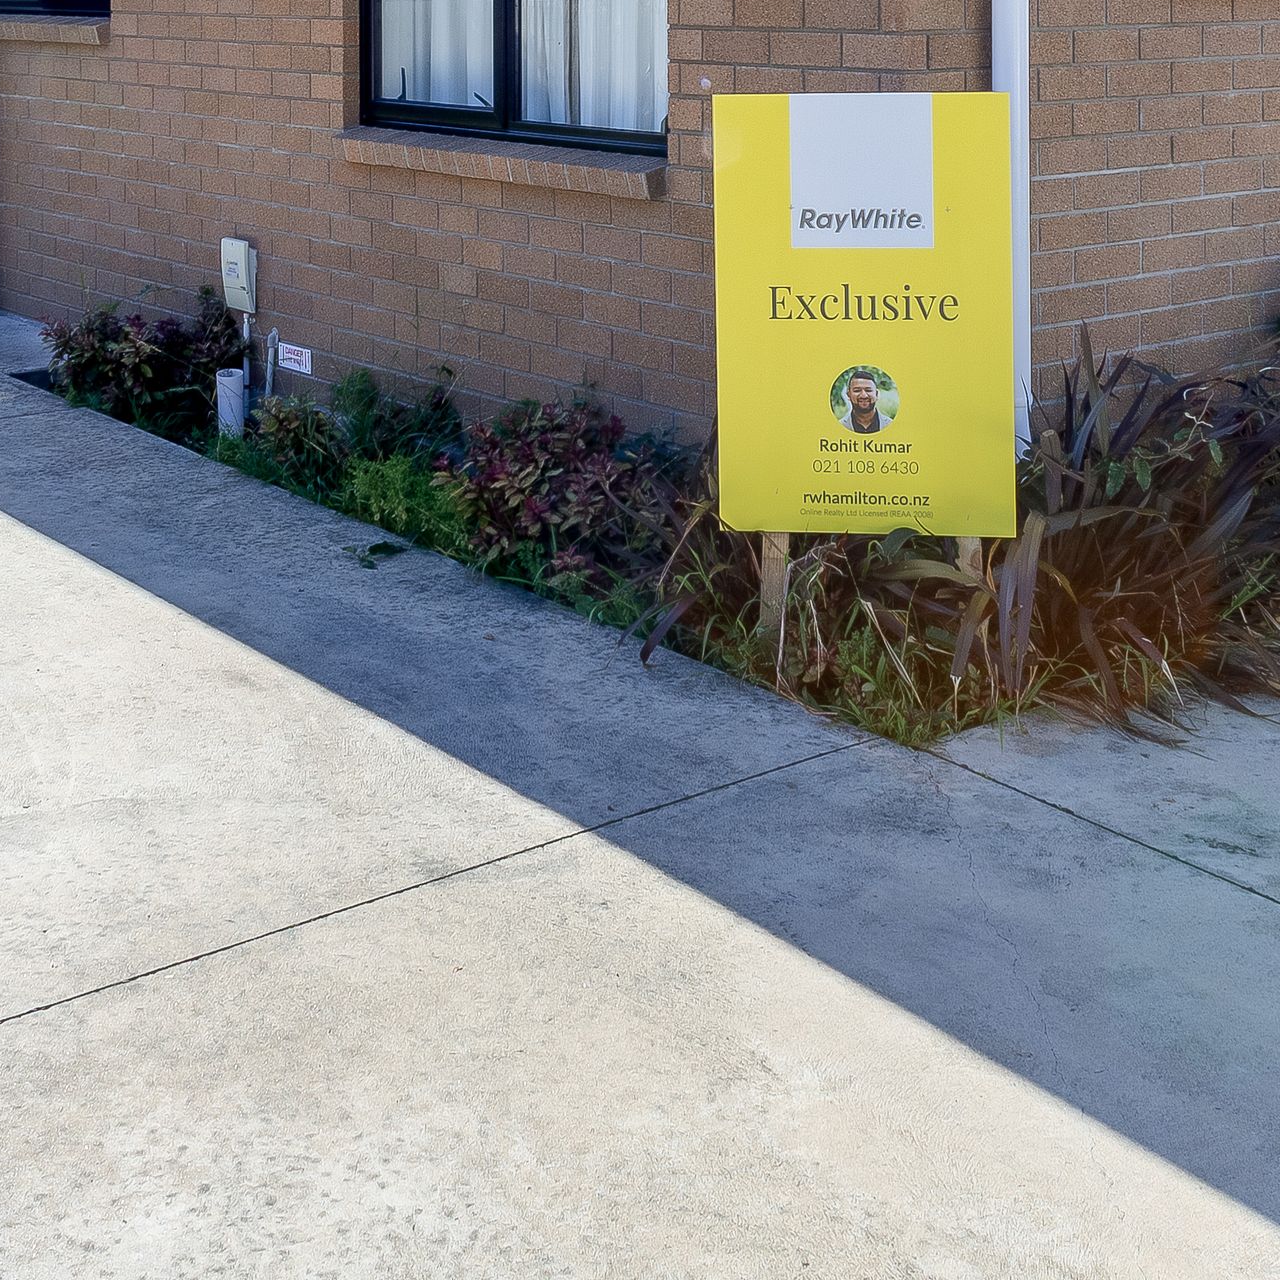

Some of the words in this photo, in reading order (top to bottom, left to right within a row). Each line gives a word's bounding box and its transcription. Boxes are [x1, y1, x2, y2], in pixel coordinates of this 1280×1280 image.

[769, 283, 959, 321] Exclusive
[819, 439, 859, 453] Rohit
[863, 439, 912, 454] Kumar
[812, 459, 841, 473] 021
[847, 460, 875, 474] 108
[880, 461, 919, 475] 6430
[803, 490, 930, 506] rwhamilton.co.nz
[799, 508, 822, 516] Online
[823, 508, 845, 517] Realty
[846, 509, 858, 517] Ltd
[859, 510, 888, 518] Licensed
[889, 510, 912, 518] (REAA
